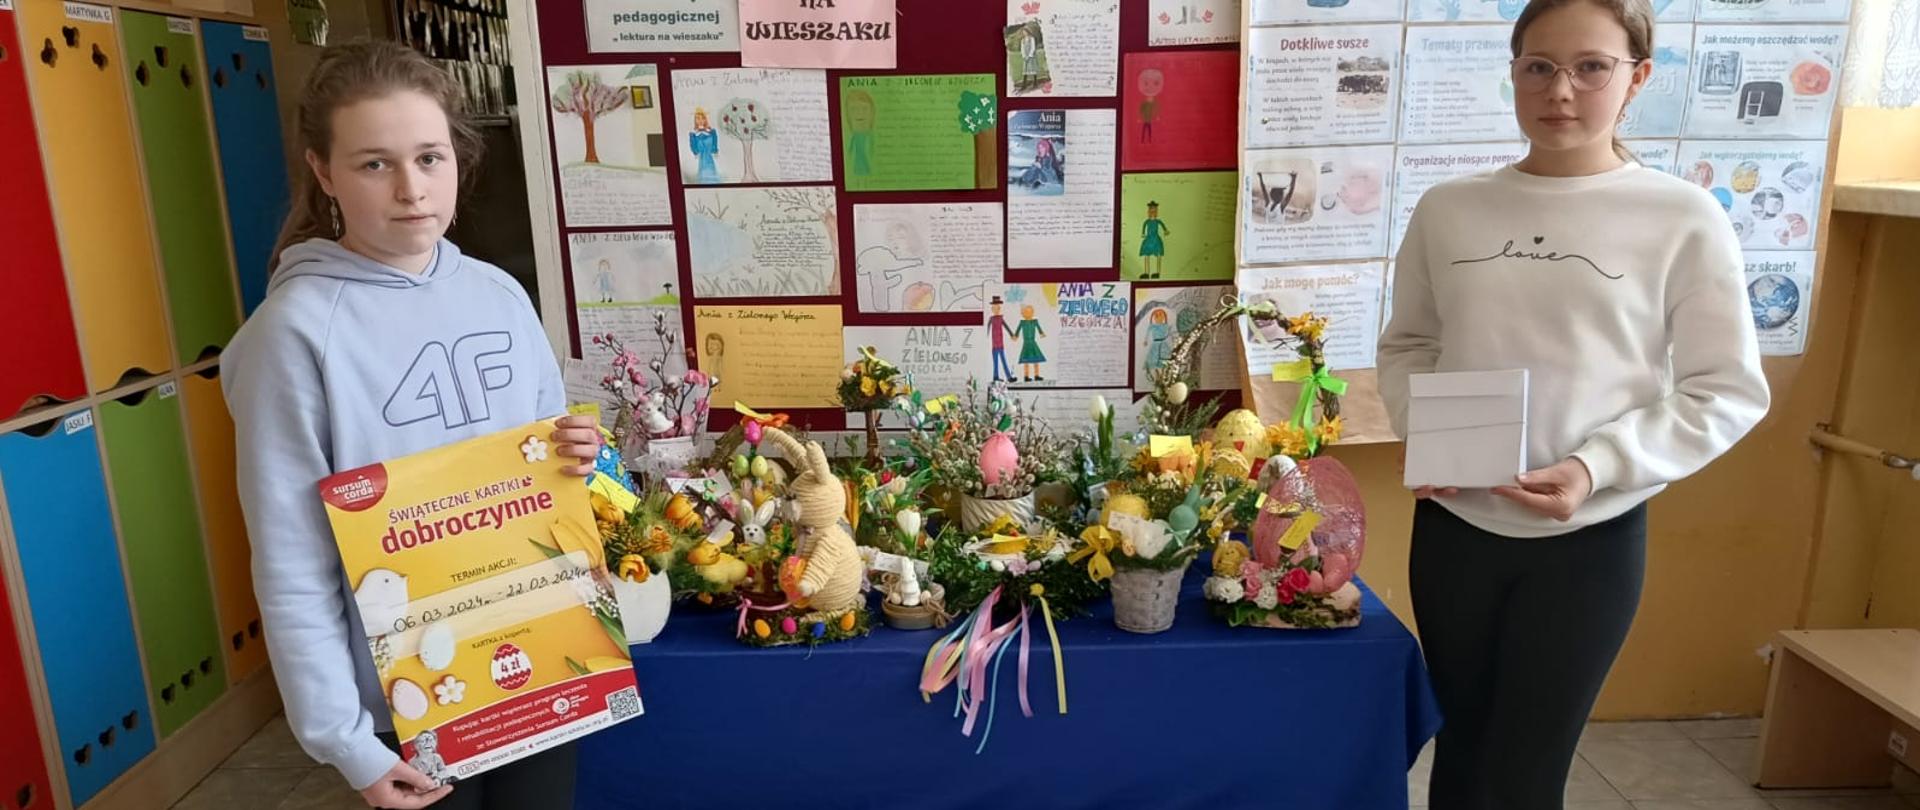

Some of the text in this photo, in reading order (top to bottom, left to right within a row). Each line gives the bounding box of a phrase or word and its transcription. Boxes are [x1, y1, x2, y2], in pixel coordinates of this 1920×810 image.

[613, 10, 720, 26] pedagogicznej
[745, 21, 892, 41] WIESZAKU
[1281, 37, 1369, 52] Dotkliwe susze
[1421, 38, 1464, 54] Tematy
[1701, 34, 1839, 46] Jak możemy oszczędzać wodę?
[1038, 112, 1061, 122] Ania
[1640, 147, 1669, 159] wodę?
[1402, 154, 1456, 169] Organizacje
[1457, 154, 1491, 167] niosące
[1758, 261, 1798, 273] skarb!
[1262, 271, 1361, 291] Jak mogę pomóc?
[1057, 282, 1115, 299] ANIA Z
[1058, 297, 1129, 318] ZIELONEGO
[697, 308, 722, 319] Ania
[736, 310, 779, 322] Zielonego
[781, 309, 816, 324] Wzgórza
[905, 327, 975, 348] ANIA Z
[901, 347, 968, 365] ZIELONEGO
[332, 479, 372, 495] sursum
[344, 486, 374, 500] corda
[389, 478, 521, 524] ŚWIĄTECZNE KARTKI
[381, 491, 553, 555] dobroczynne
[450, 557, 518, 583] TERMIN AKCJI:
[501, 662, 509, 673] 4
